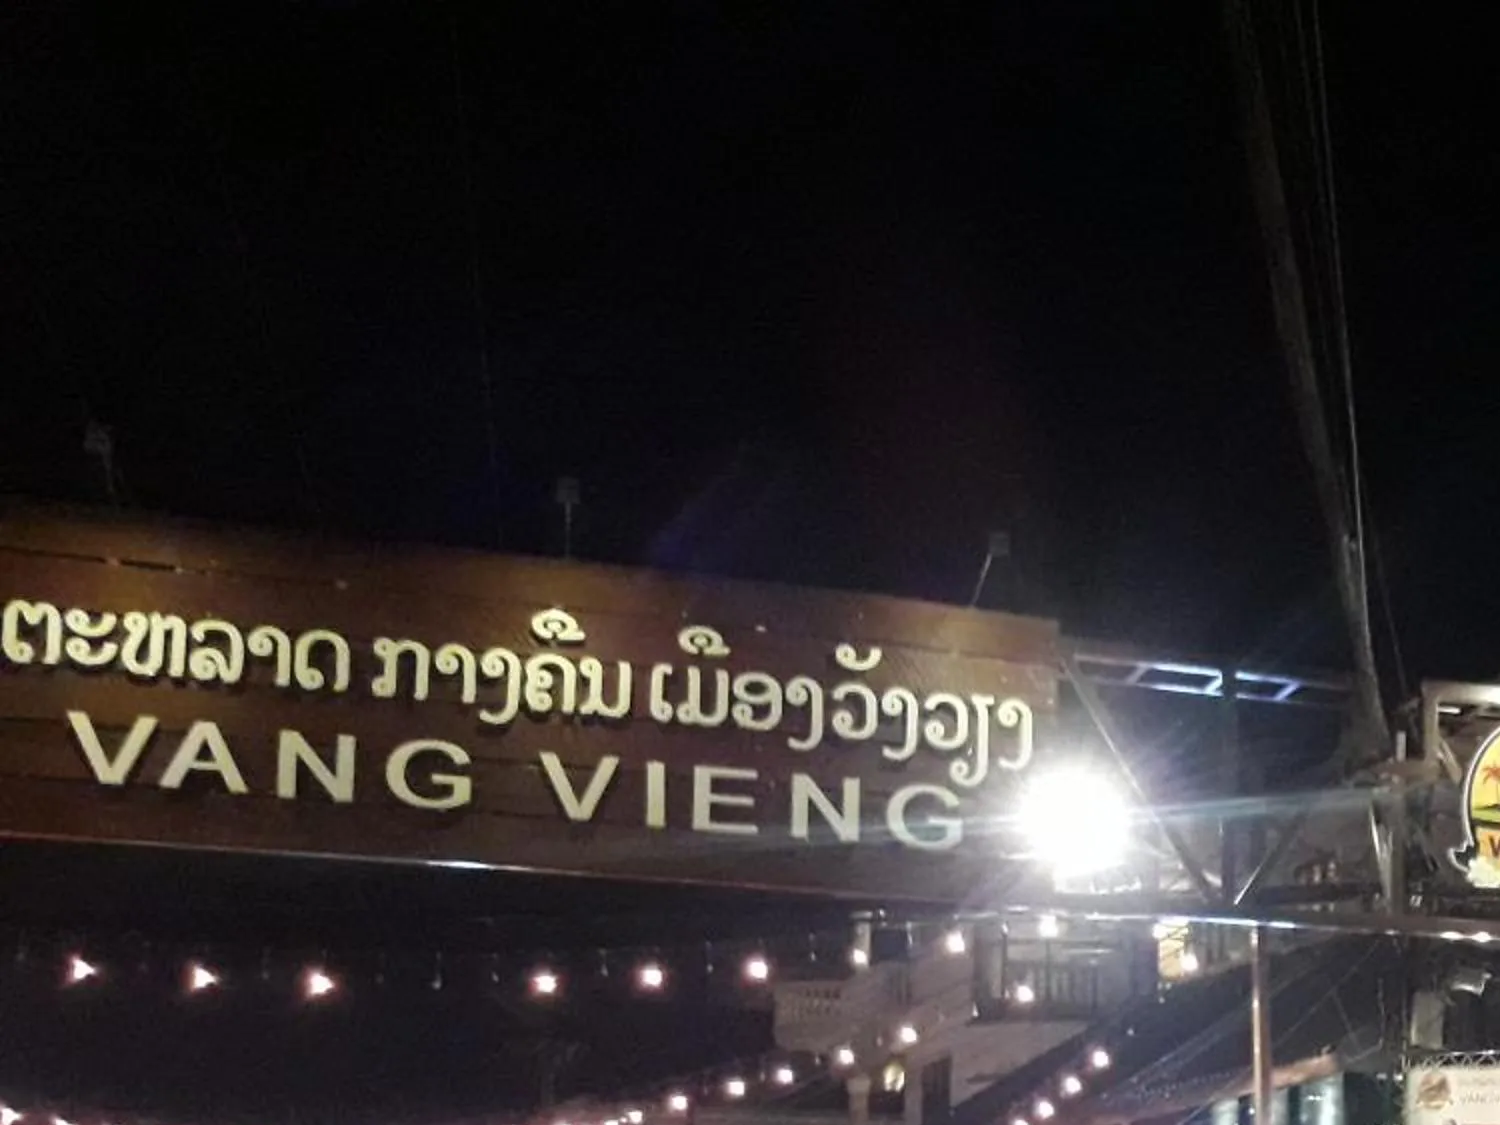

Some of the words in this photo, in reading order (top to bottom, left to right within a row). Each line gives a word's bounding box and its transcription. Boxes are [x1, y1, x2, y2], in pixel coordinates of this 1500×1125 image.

[2, 599, 350, 692] ຕະຫລາດ
[371, 608, 632, 724] ກາງຄືນ
[66, 710, 473, 810] VANG
[539, 751, 964, 851] VIENG
